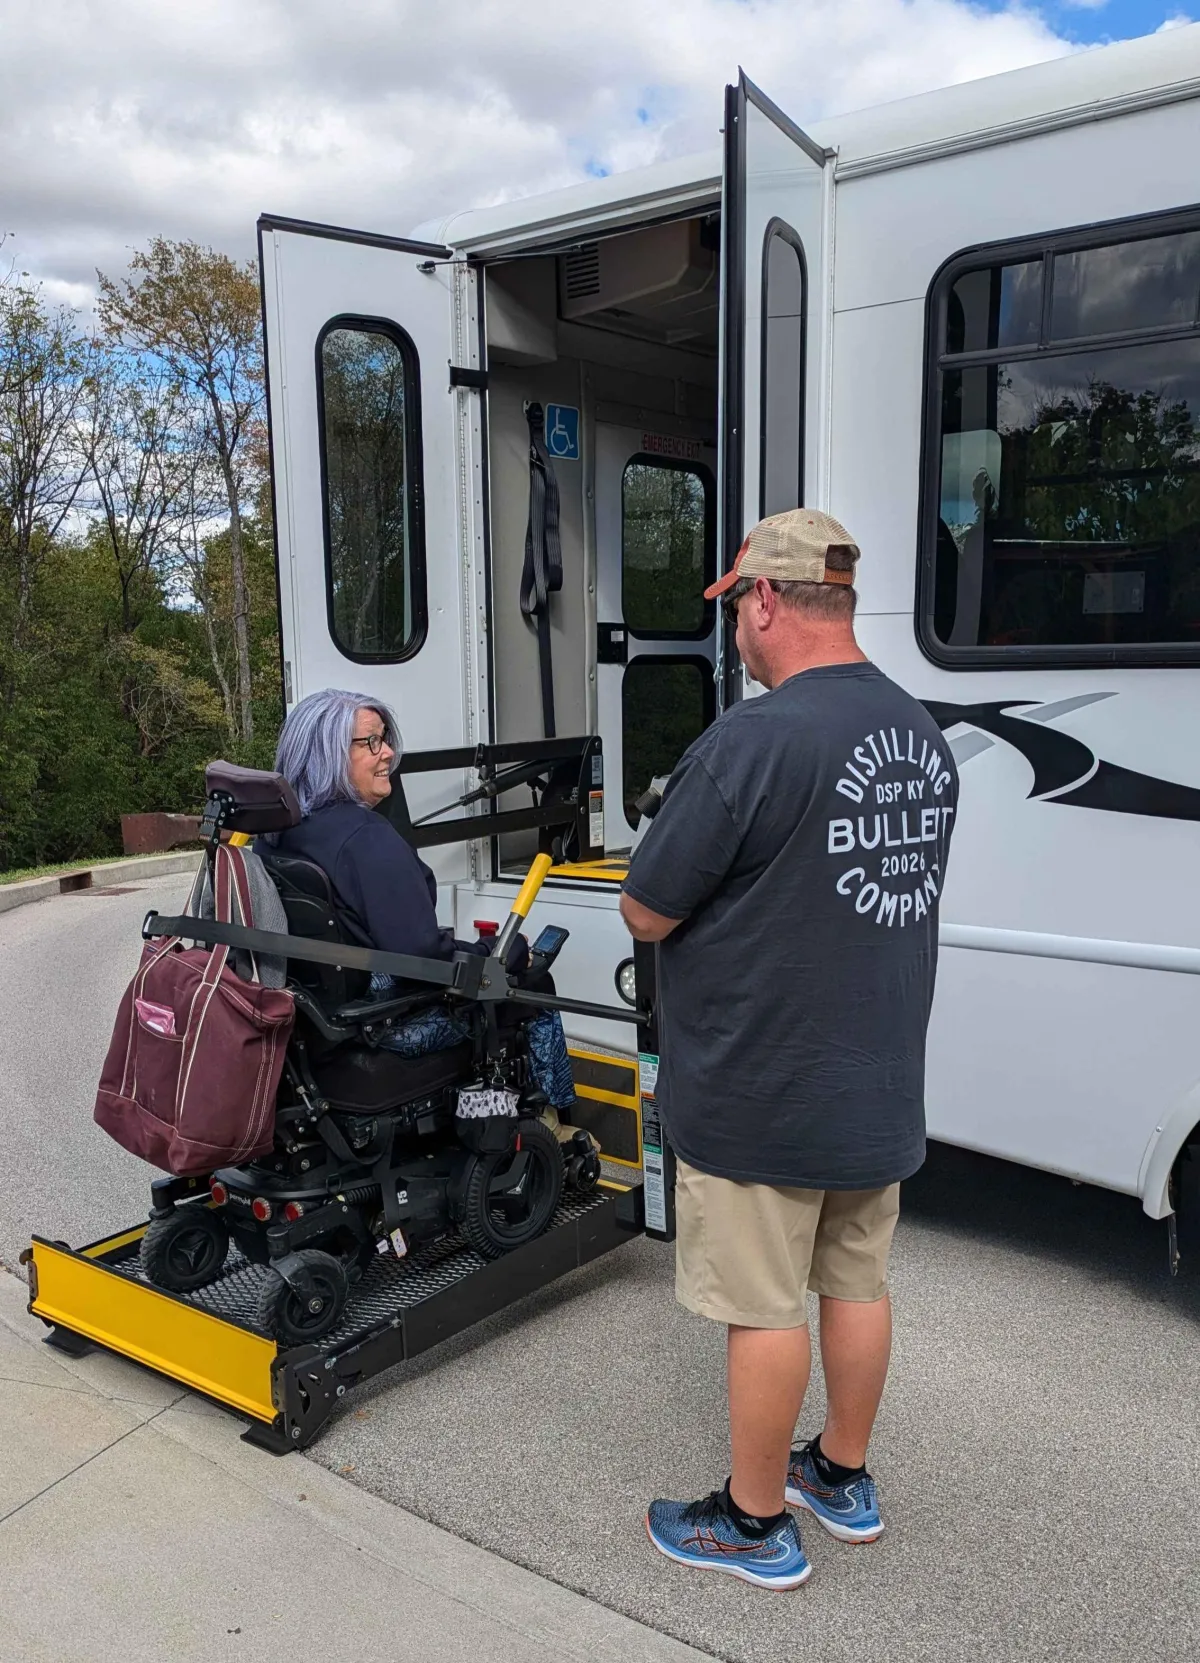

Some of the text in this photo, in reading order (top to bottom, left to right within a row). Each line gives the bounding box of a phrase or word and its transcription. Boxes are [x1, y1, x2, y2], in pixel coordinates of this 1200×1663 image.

[643, 433, 701, 459] EMERGENCY EXIT
[836, 728, 951, 804] DISTILLING
[876, 780, 925, 804] DSP KY
[828, 807, 953, 854] BULLEIT
[881, 852, 925, 877] 20026
[397, 1190, 408, 1205] F5
